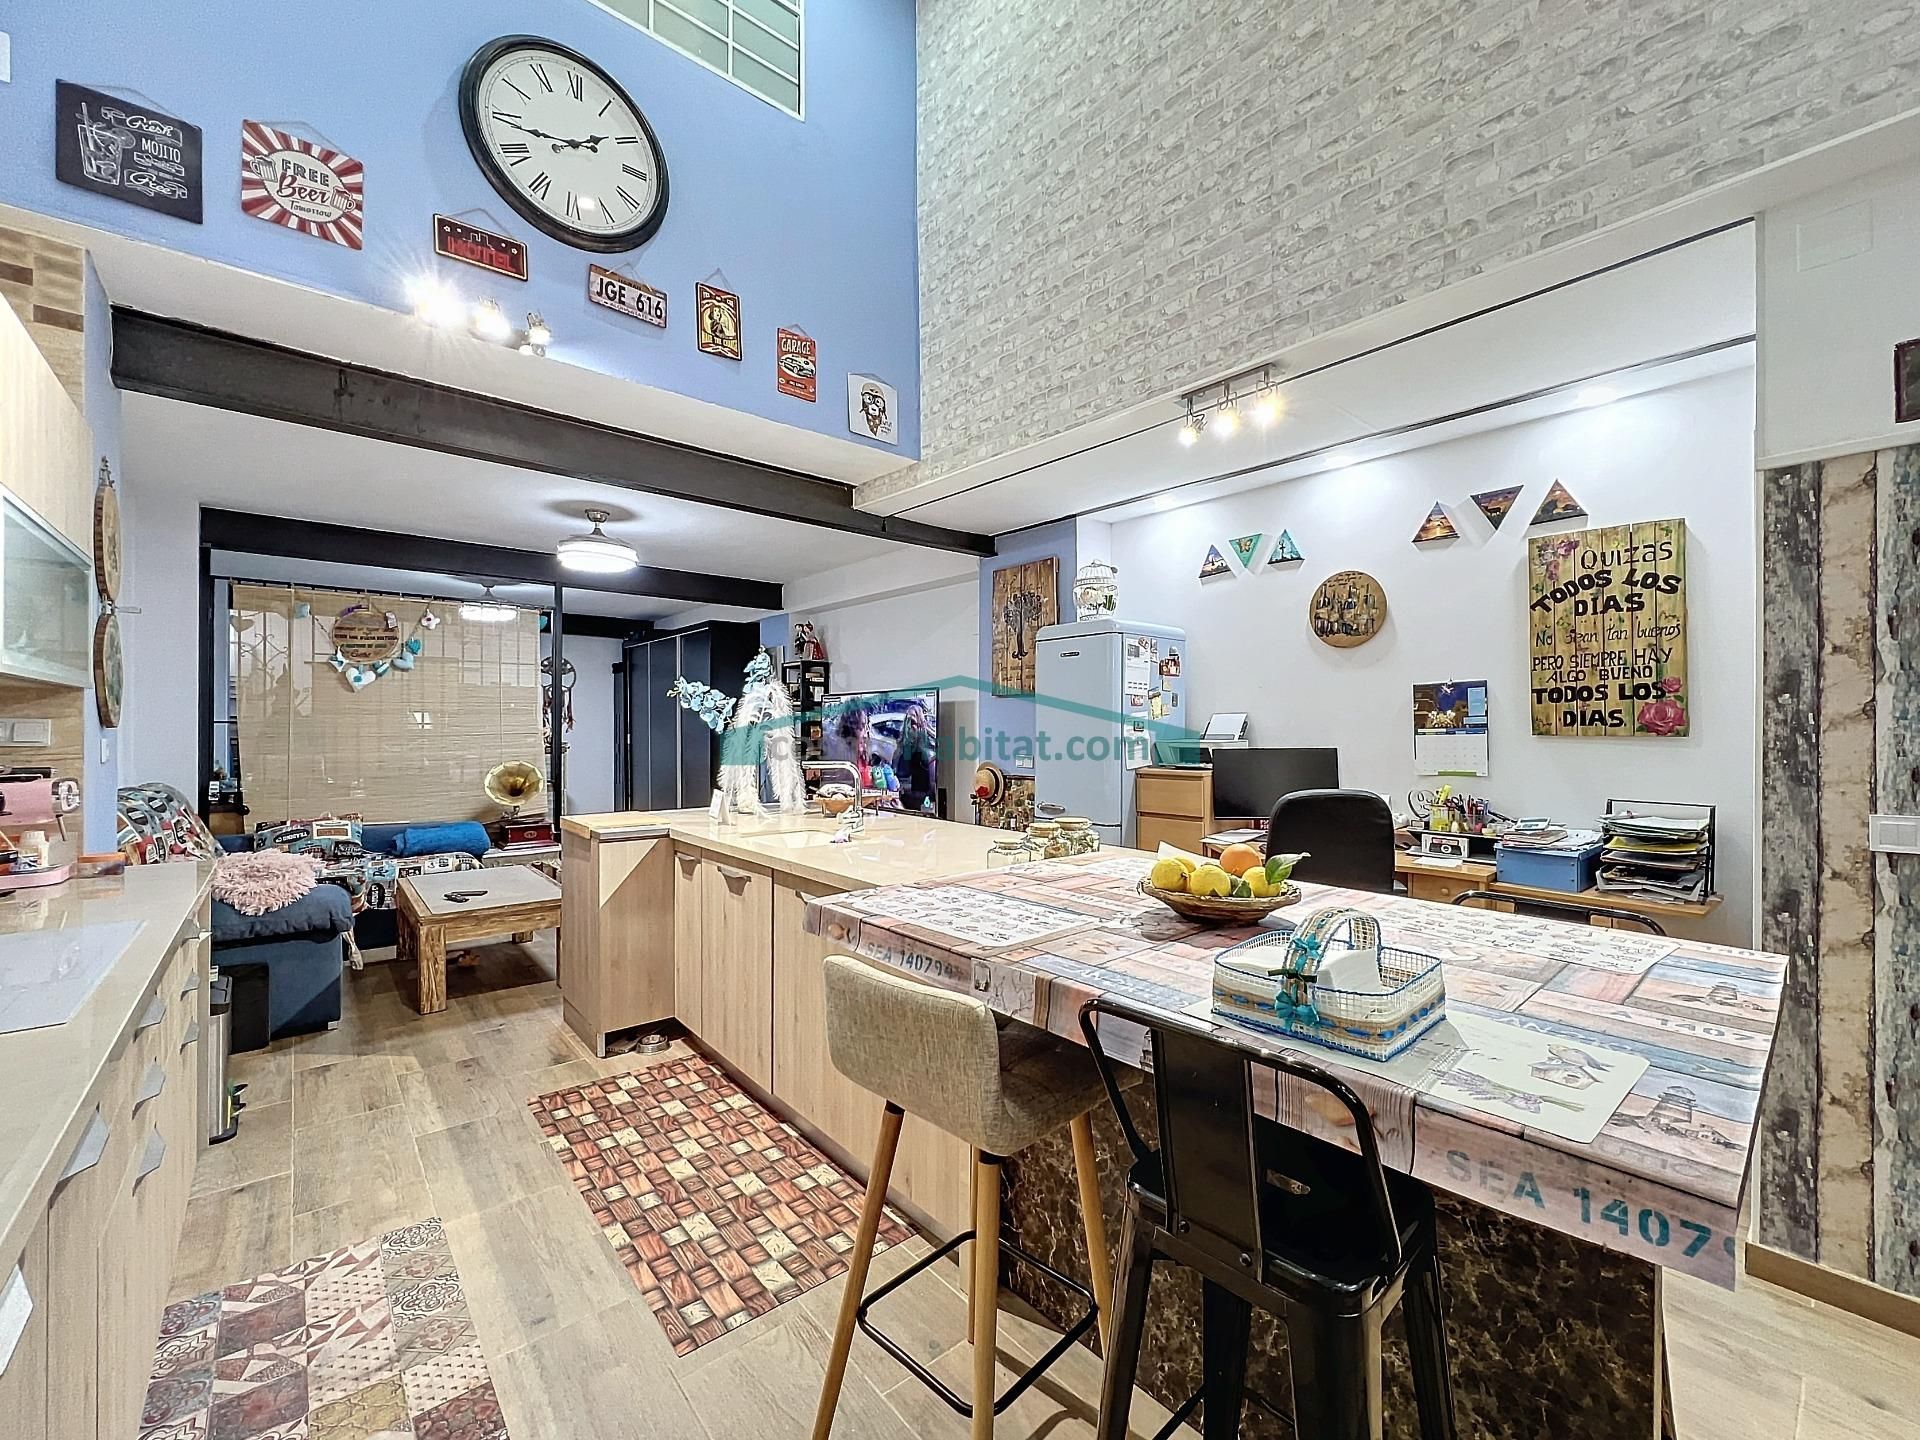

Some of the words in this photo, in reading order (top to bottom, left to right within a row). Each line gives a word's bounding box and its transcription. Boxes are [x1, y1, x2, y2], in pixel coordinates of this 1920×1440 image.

[141, 137, 181, 163] MOJITO
[281, 158, 330, 188] FREE
[276, 171, 331, 204] Beer
[596, 277, 626, 306] JGE
[636, 292, 663, 320] 616
[781, 338, 811, 355] GARAGE
[1529, 569, 1613, 614] TODOS
[1621, 568, 1683, 595] LOS
[1532, 655, 1564, 672] PERO
[1569, 650, 1626, 669] SIEMPRE
[1634, 647, 1673, 666] HAY
[1546, 669, 1587, 684] ALGO
[1599, 665, 1653, 681] BUENO
[1530, 684, 1609, 705] TODOS
[1618, 681, 1667, 701] LOS
[865, 942, 893, 964] SEA
[1446, 1149, 1546, 1210] SEA
